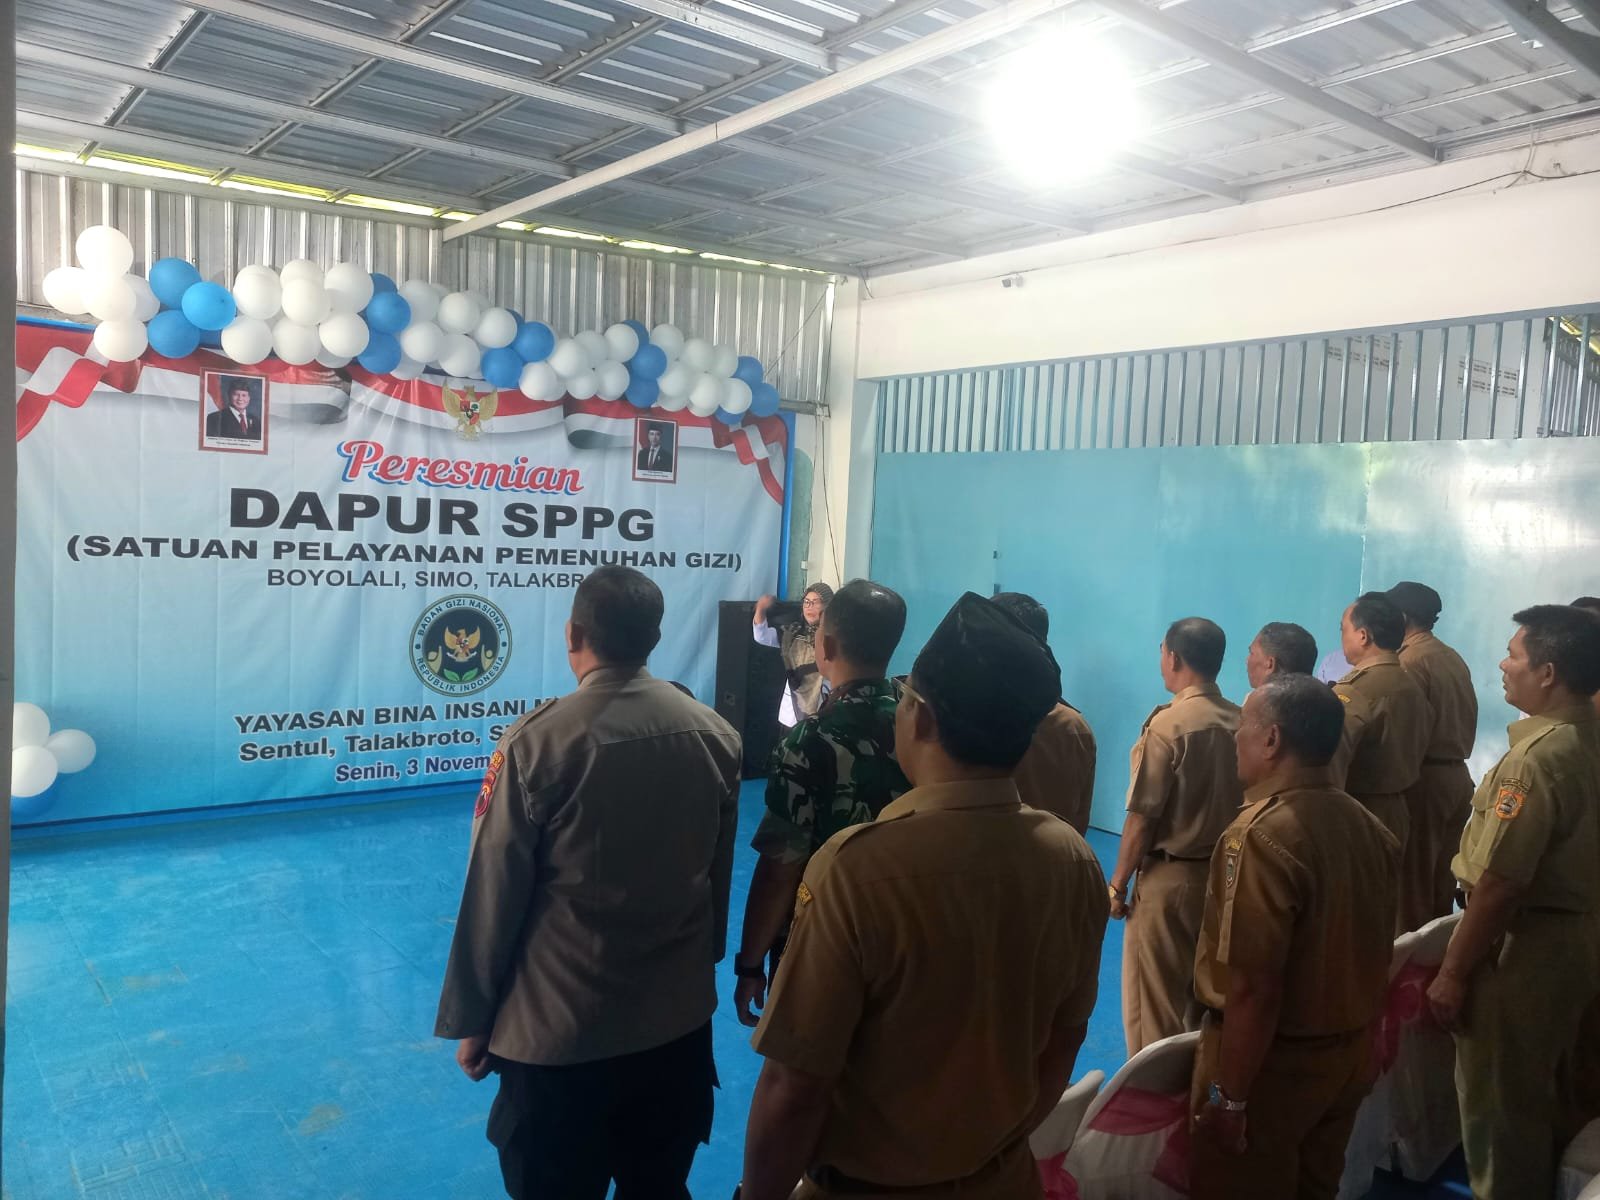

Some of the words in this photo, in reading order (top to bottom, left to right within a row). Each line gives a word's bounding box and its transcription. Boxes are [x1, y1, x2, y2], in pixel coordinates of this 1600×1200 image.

[336, 440, 584, 495] Peresmian
[230, 487, 481, 537] DAPUR
[501, 502, 655, 541] SPPG
[67, 534, 258, 562] (SATUAN
[273, 540, 484, 565] PELAYANAN
[495, 547, 676, 568] PEMENUHAN
[685, 552, 742, 573] GIZI)
[267, 568, 406, 591] BOYOLALI,
[415, 571, 478, 591] SIMO,
[486, 571, 585, 588] TALAKBR
[417, 606, 443, 636] BADAN
[445, 599, 466, 609] GIZI
[469, 599, 506, 635] NASIONAL
[416, 657, 457, 692] REPUBLIK
[460, 656, 505, 692] INDONESIA
[234, 709, 365, 734] YAYASAN
[374, 704, 437, 726] BINA
[445, 699, 526, 720] INSANI
[239, 736, 336, 762] Sentul,
[344, 725, 481, 754] Talakbroto,
[335, 762, 400, 783] Senin,
[406, 761, 418, 775] 3
[425, 751, 497, 774] Novem
